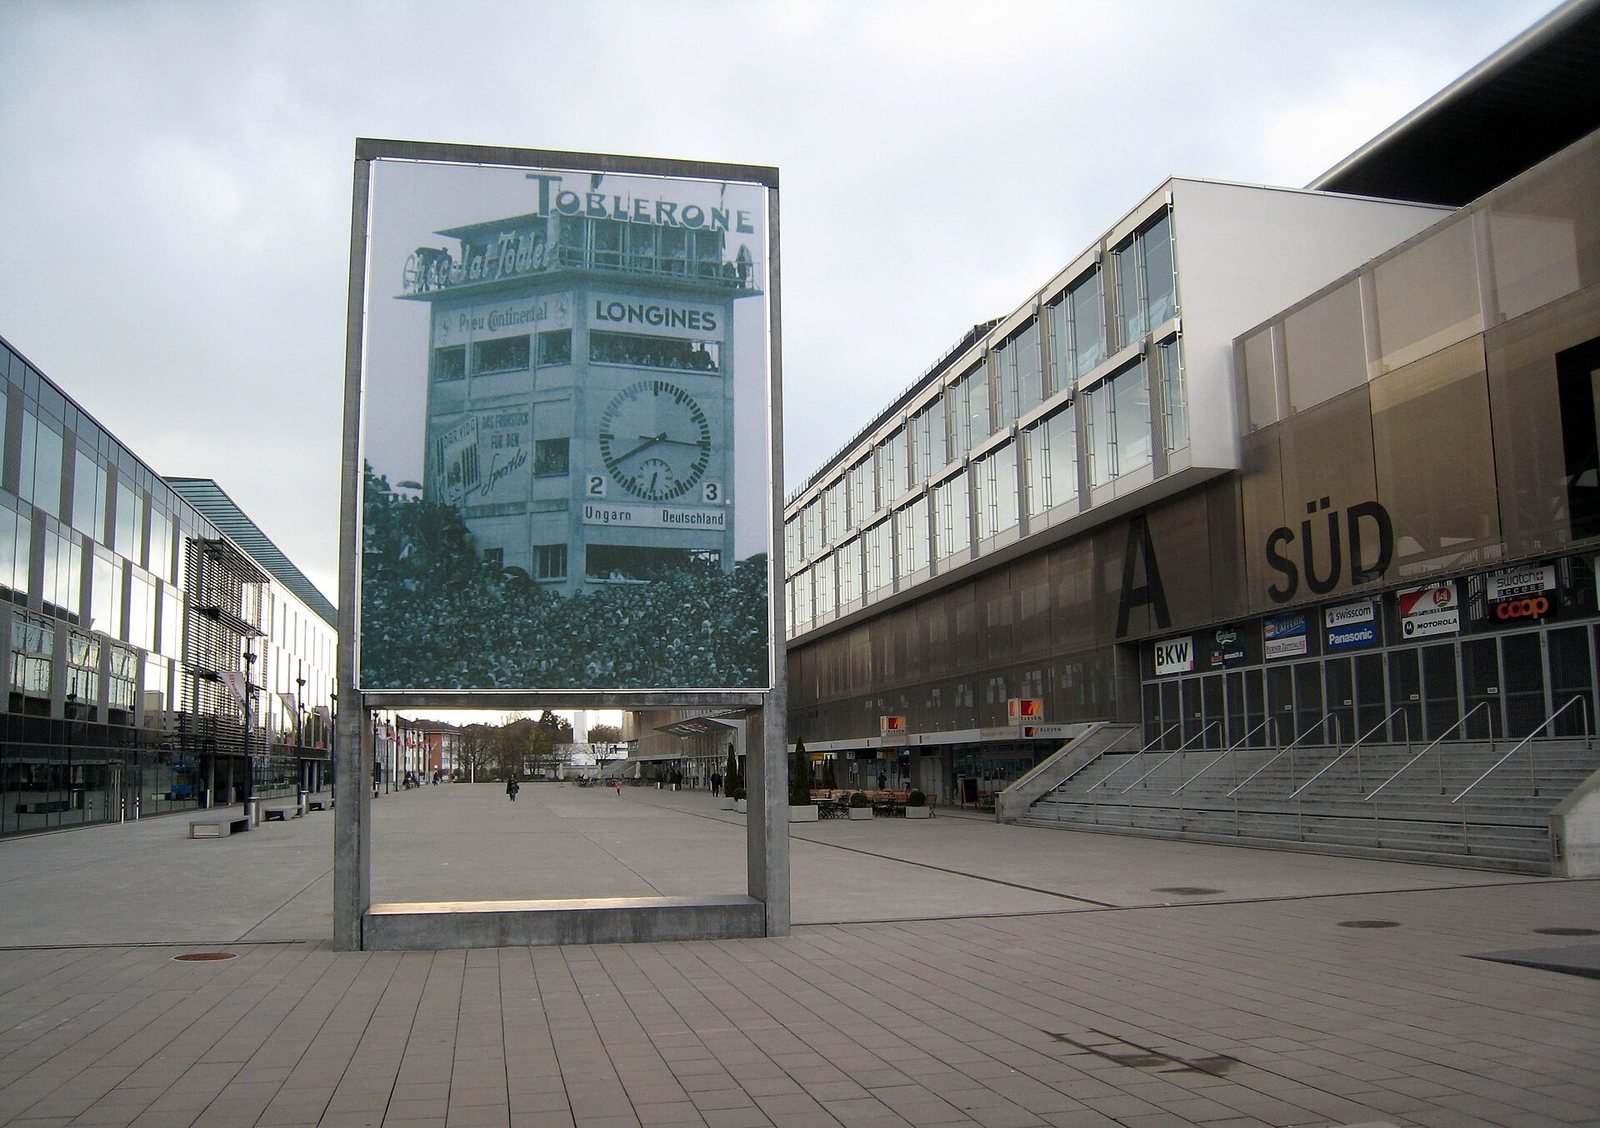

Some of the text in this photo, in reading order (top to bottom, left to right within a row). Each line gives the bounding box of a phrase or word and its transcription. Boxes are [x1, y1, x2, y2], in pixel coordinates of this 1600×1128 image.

[526, 174, 754, 234] TOBLERONE
[595, 300, 717, 331] LONGINES
[590, 476, 603, 495] 2
[705, 483, 718, 501] 3
[585, 506, 632, 523] Ungarn
[662, 509, 724, 526] Deutschland
[1265, 497, 1394, 602] SÜD
[1497, 570, 1536, 588] swatch
[1497, 583, 1545, 597] access
[1335, 606, 1371, 620] swisscom
[1496, 597, 1549, 620] coop
[1417, 618, 1457, 630] MOTOROLA
[1328, 628, 1373, 645] Panasonic
[1157, 642, 1188, 667] BKW
